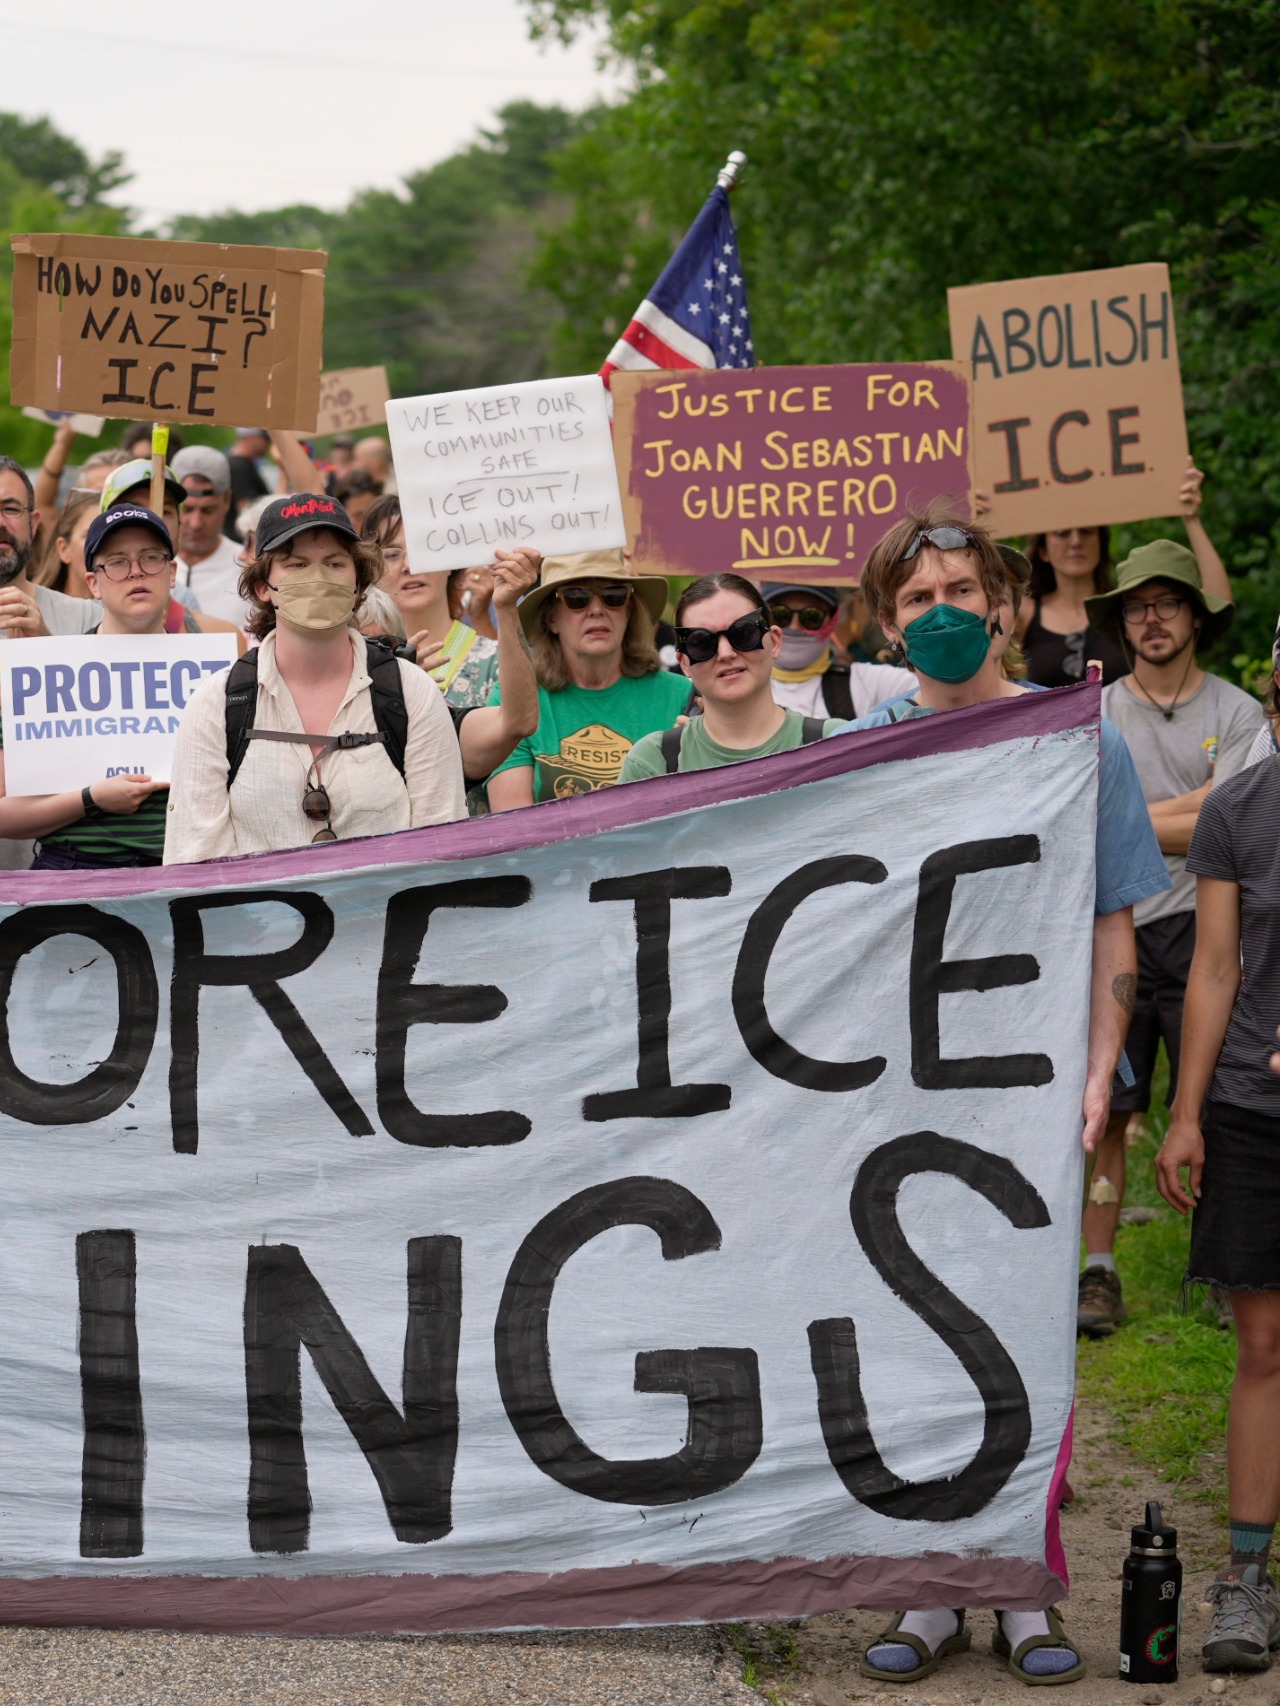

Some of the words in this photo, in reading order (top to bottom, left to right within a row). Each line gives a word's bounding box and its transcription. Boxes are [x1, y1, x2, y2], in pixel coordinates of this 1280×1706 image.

[38, 257, 102, 297] HOW
[113, 266, 142, 298] DO
[145, 268, 185, 305] YOU
[189, 274, 272, 318] SPELL
[80, 306, 267, 369] NAZI?
[970, 291, 1170, 380] ABOLISH
[403, 404, 454, 432] WE
[466, 396, 521, 424] KEEP
[537, 392, 585, 416] OUR
[654, 382, 832, 420] JUSTICE
[866, 374, 940, 410] FOR
[424, 422, 584, 458] COMMUNITIES
[480, 450, 538, 474] SAFE
[643, 440, 742, 478] JOAN
[760, 426, 964, 471] SEBASTIAN
[987, 406, 1154, 494] I.C.E.
[428, 488, 485, 518] ICE
[498, 474, 580, 508] OUT!
[682, 474, 898, 519] GUERRERO
[426, 514, 535, 552] COLLINS
[551, 504, 610, 530] OUT!
[582, 834, 1054, 1122] ICE
